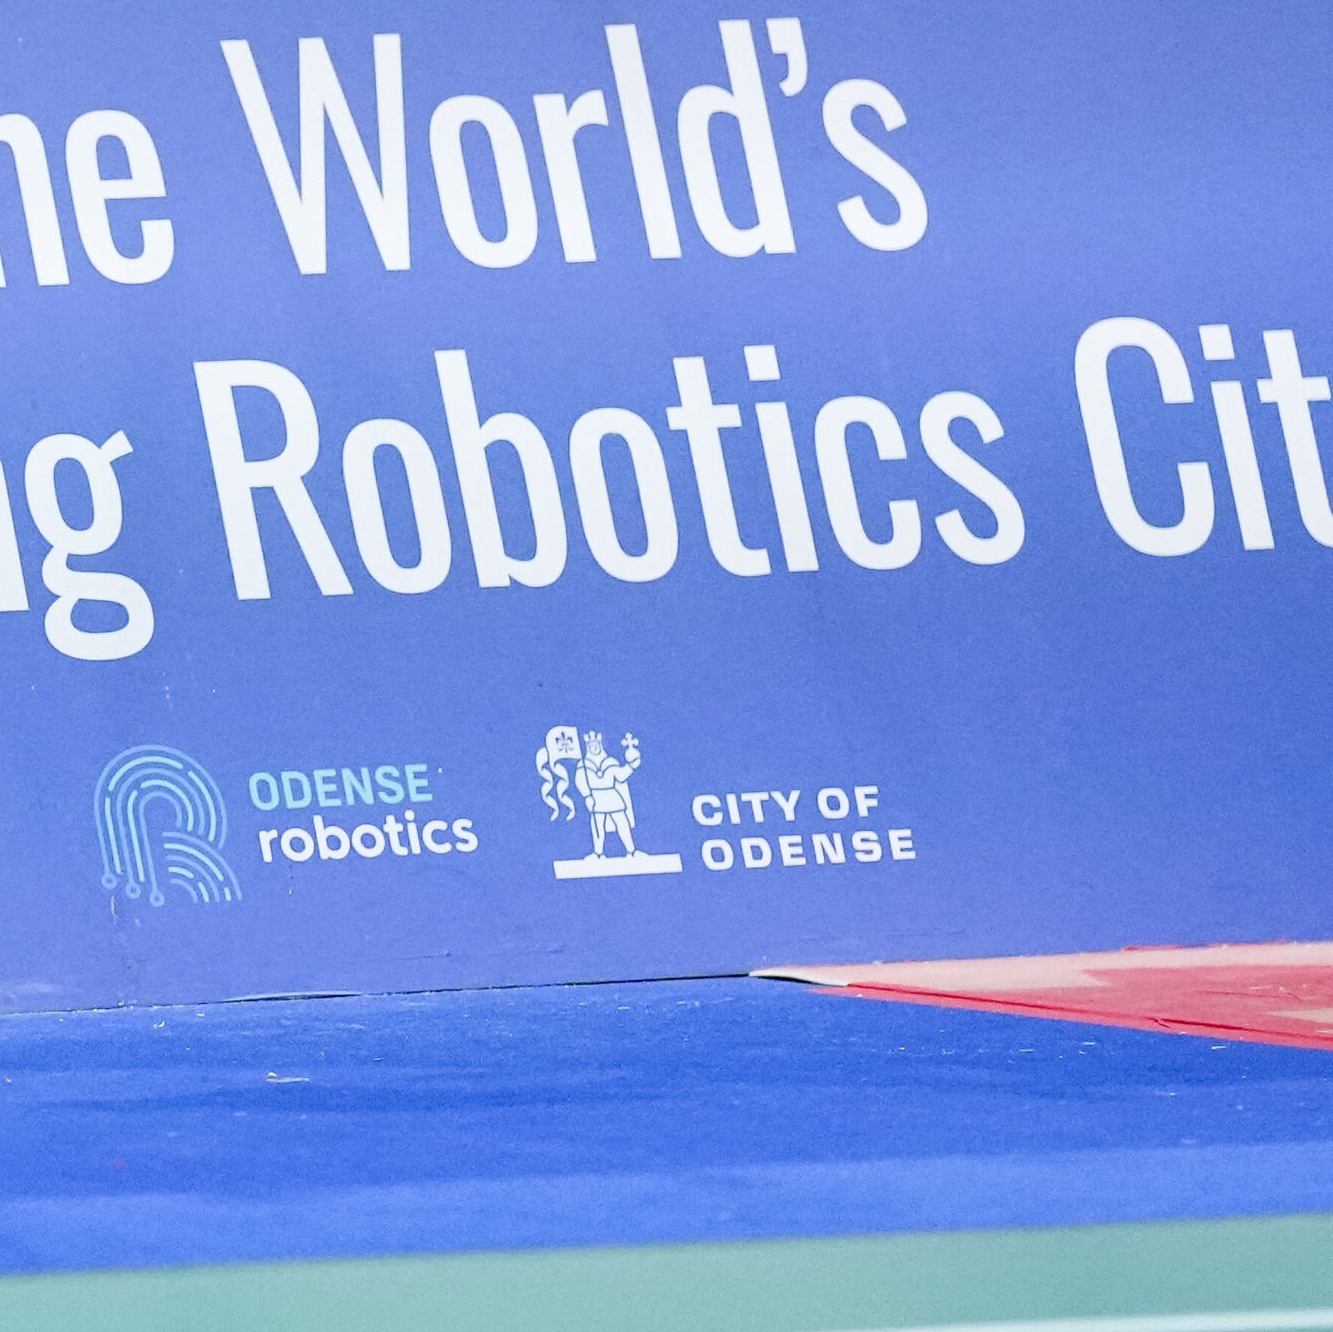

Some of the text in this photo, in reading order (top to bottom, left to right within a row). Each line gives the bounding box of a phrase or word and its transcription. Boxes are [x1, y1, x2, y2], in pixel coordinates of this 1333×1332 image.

[220, 17, 928, 275] World’s
[193, 344, 1025, 600] Robotics
[248, 763, 434, 811] ODENSE
[692, 785, 879, 826] CITY OF
[258, 809, 479, 863] robotics
[701, 828, 916, 871] ODENSE
